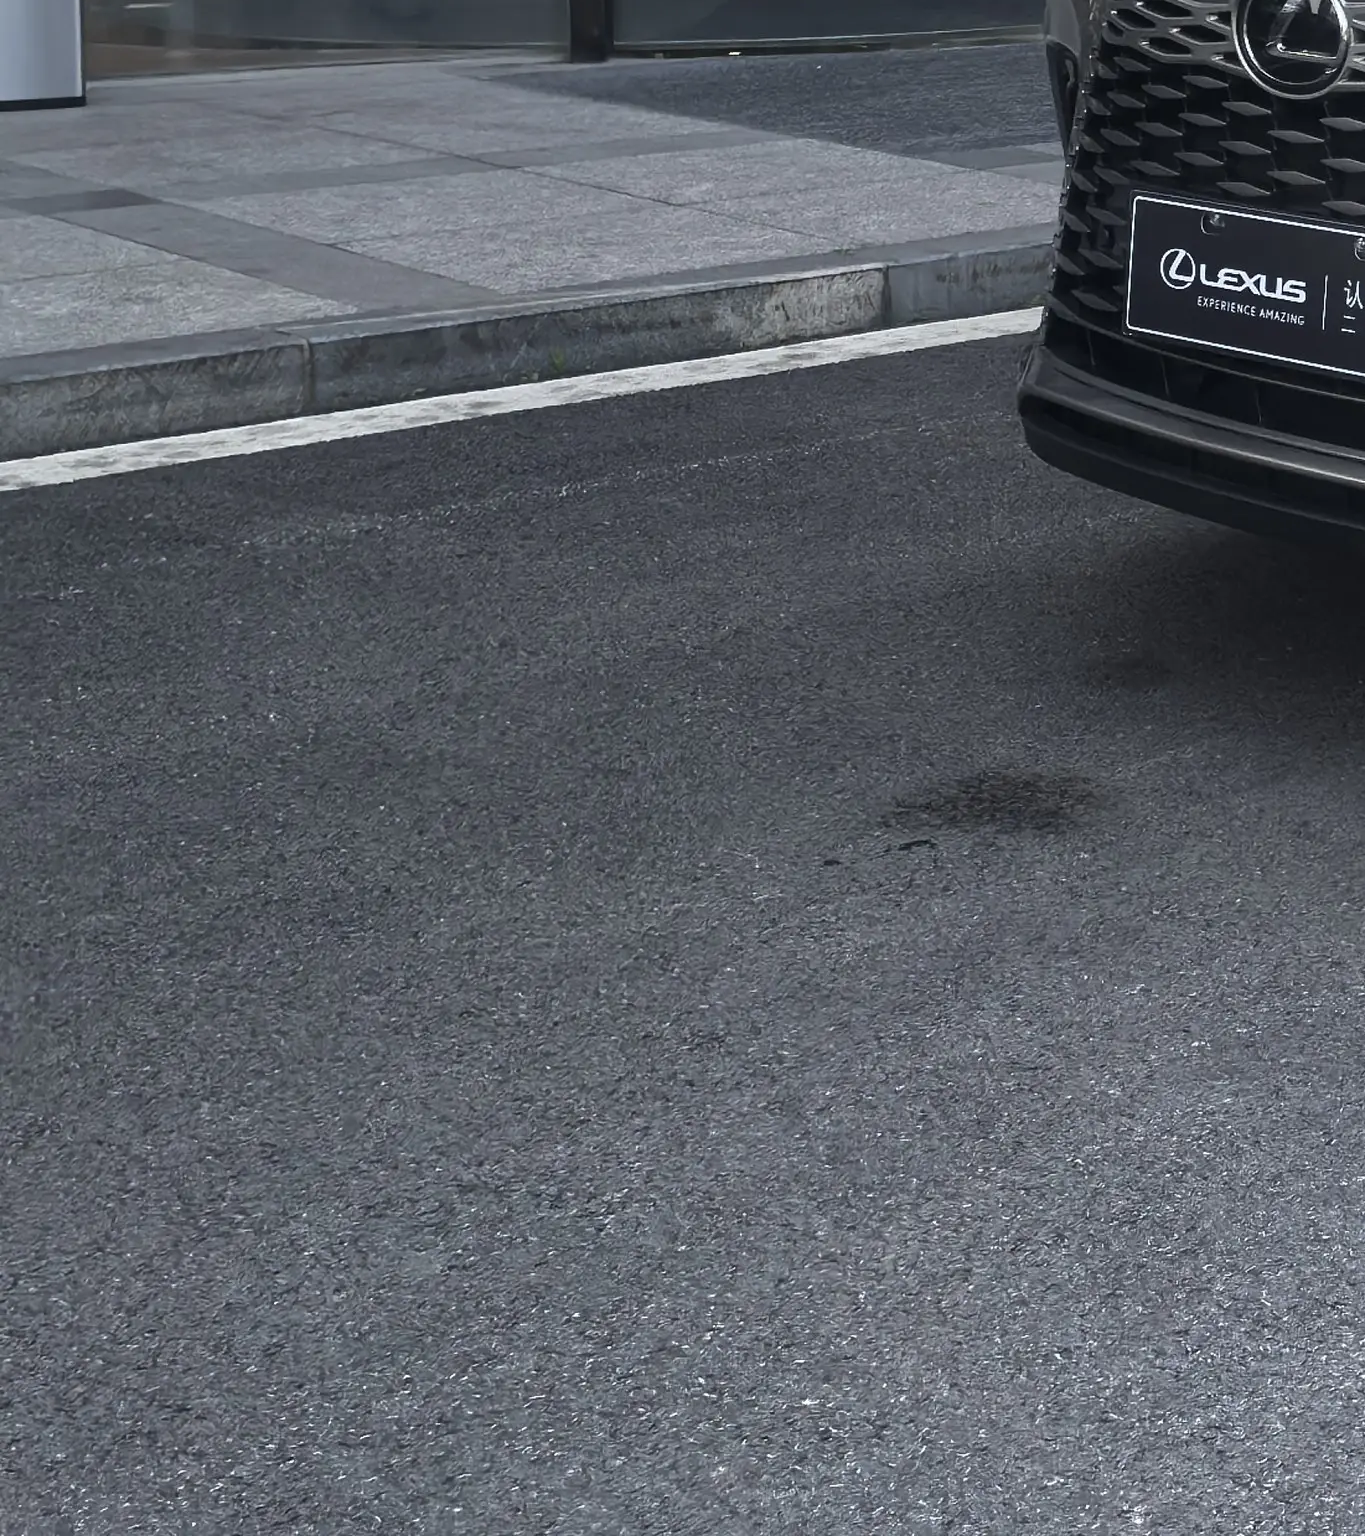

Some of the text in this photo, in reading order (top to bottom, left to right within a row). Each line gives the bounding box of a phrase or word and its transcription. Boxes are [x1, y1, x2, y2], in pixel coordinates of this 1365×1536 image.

[1200, 263, 1307, 304] LEXUS
[1197, 295, 1306, 326] EXPERIENCE AMAZING
